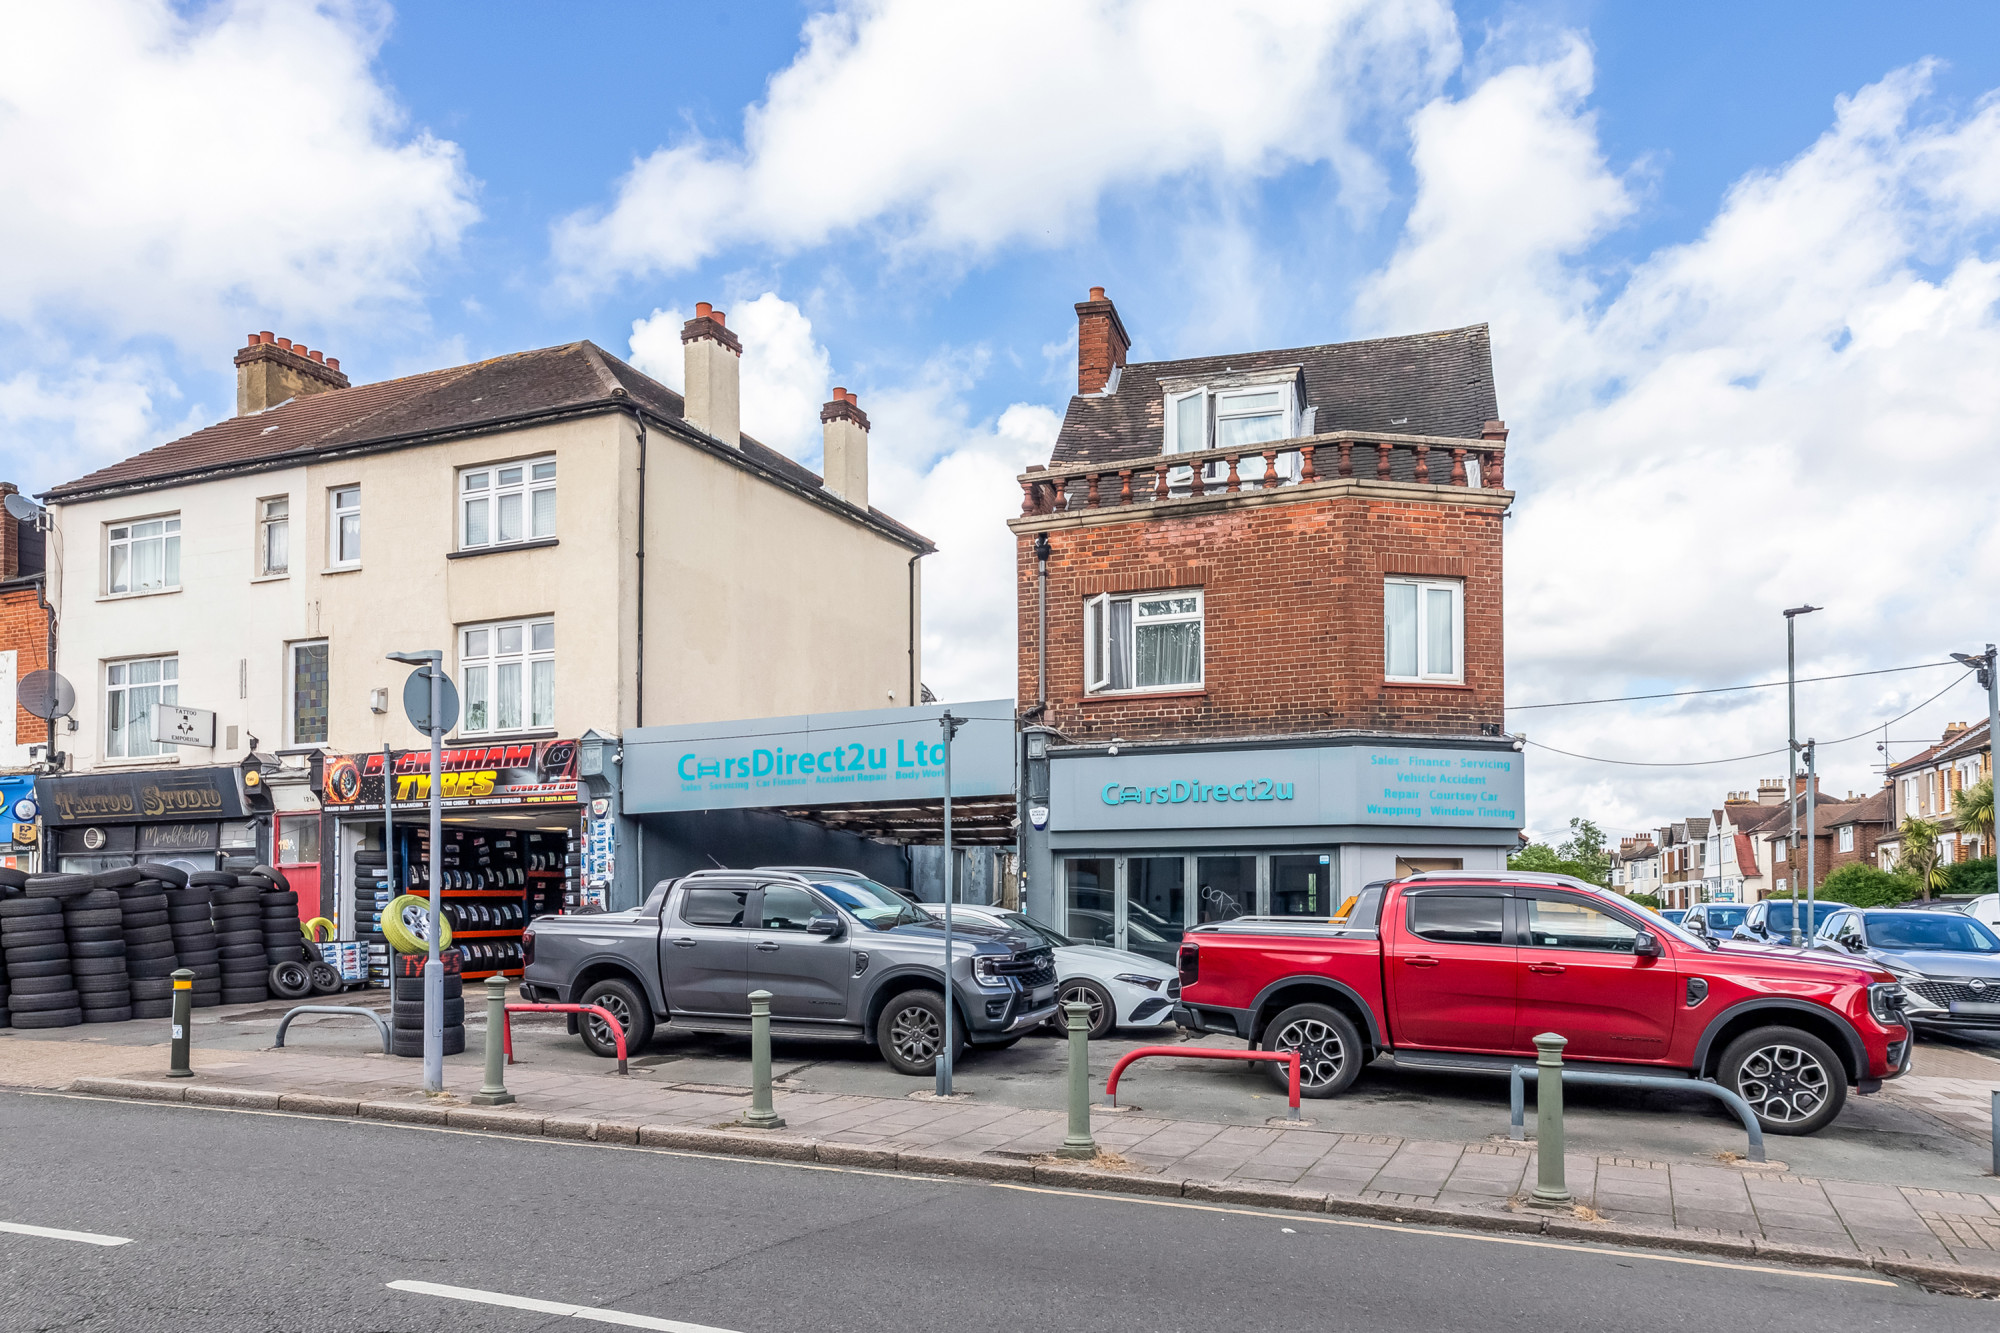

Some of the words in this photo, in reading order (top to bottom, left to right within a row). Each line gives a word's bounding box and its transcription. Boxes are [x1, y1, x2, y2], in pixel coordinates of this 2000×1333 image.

[175, 708, 197, 716] TATTOO
[171, 735, 200, 743] EMPORIUM
[363, 745, 534, 777] BCKNHAM
[897, 739, 946, 767] Ltd
[1370, 754, 1399, 766] Sales
[1409, 756, 1451, 768] Finance
[1460, 758, 1511, 772] Servicing
[395, 770, 498, 801] TYRES
[681, 783, 702, 792] Sales
[709, 780, 749, 791] Servicing
[756, 779, 771, 788] Car
[773, 777, 807, 787] Finance
[815, 775, 855, 784] Accident
[857, 772, 888, 783] Repair
[895, 770, 920, 781] Body
[1396, 772, 1436, 783] Vehicle
[1439, 773, 1486, 785] Accident
[1384, 788, 1420, 801] Repair
[1429, 790, 1478, 803] Courtsey
[1480, 791, 1498, 802] Car
[1367, 804, 1422, 818] Wrapping
[1430, 805, 1474, 817] Window
[1477, 806, 1515, 820] Tinting
[402, 953, 460, 977] TYES
